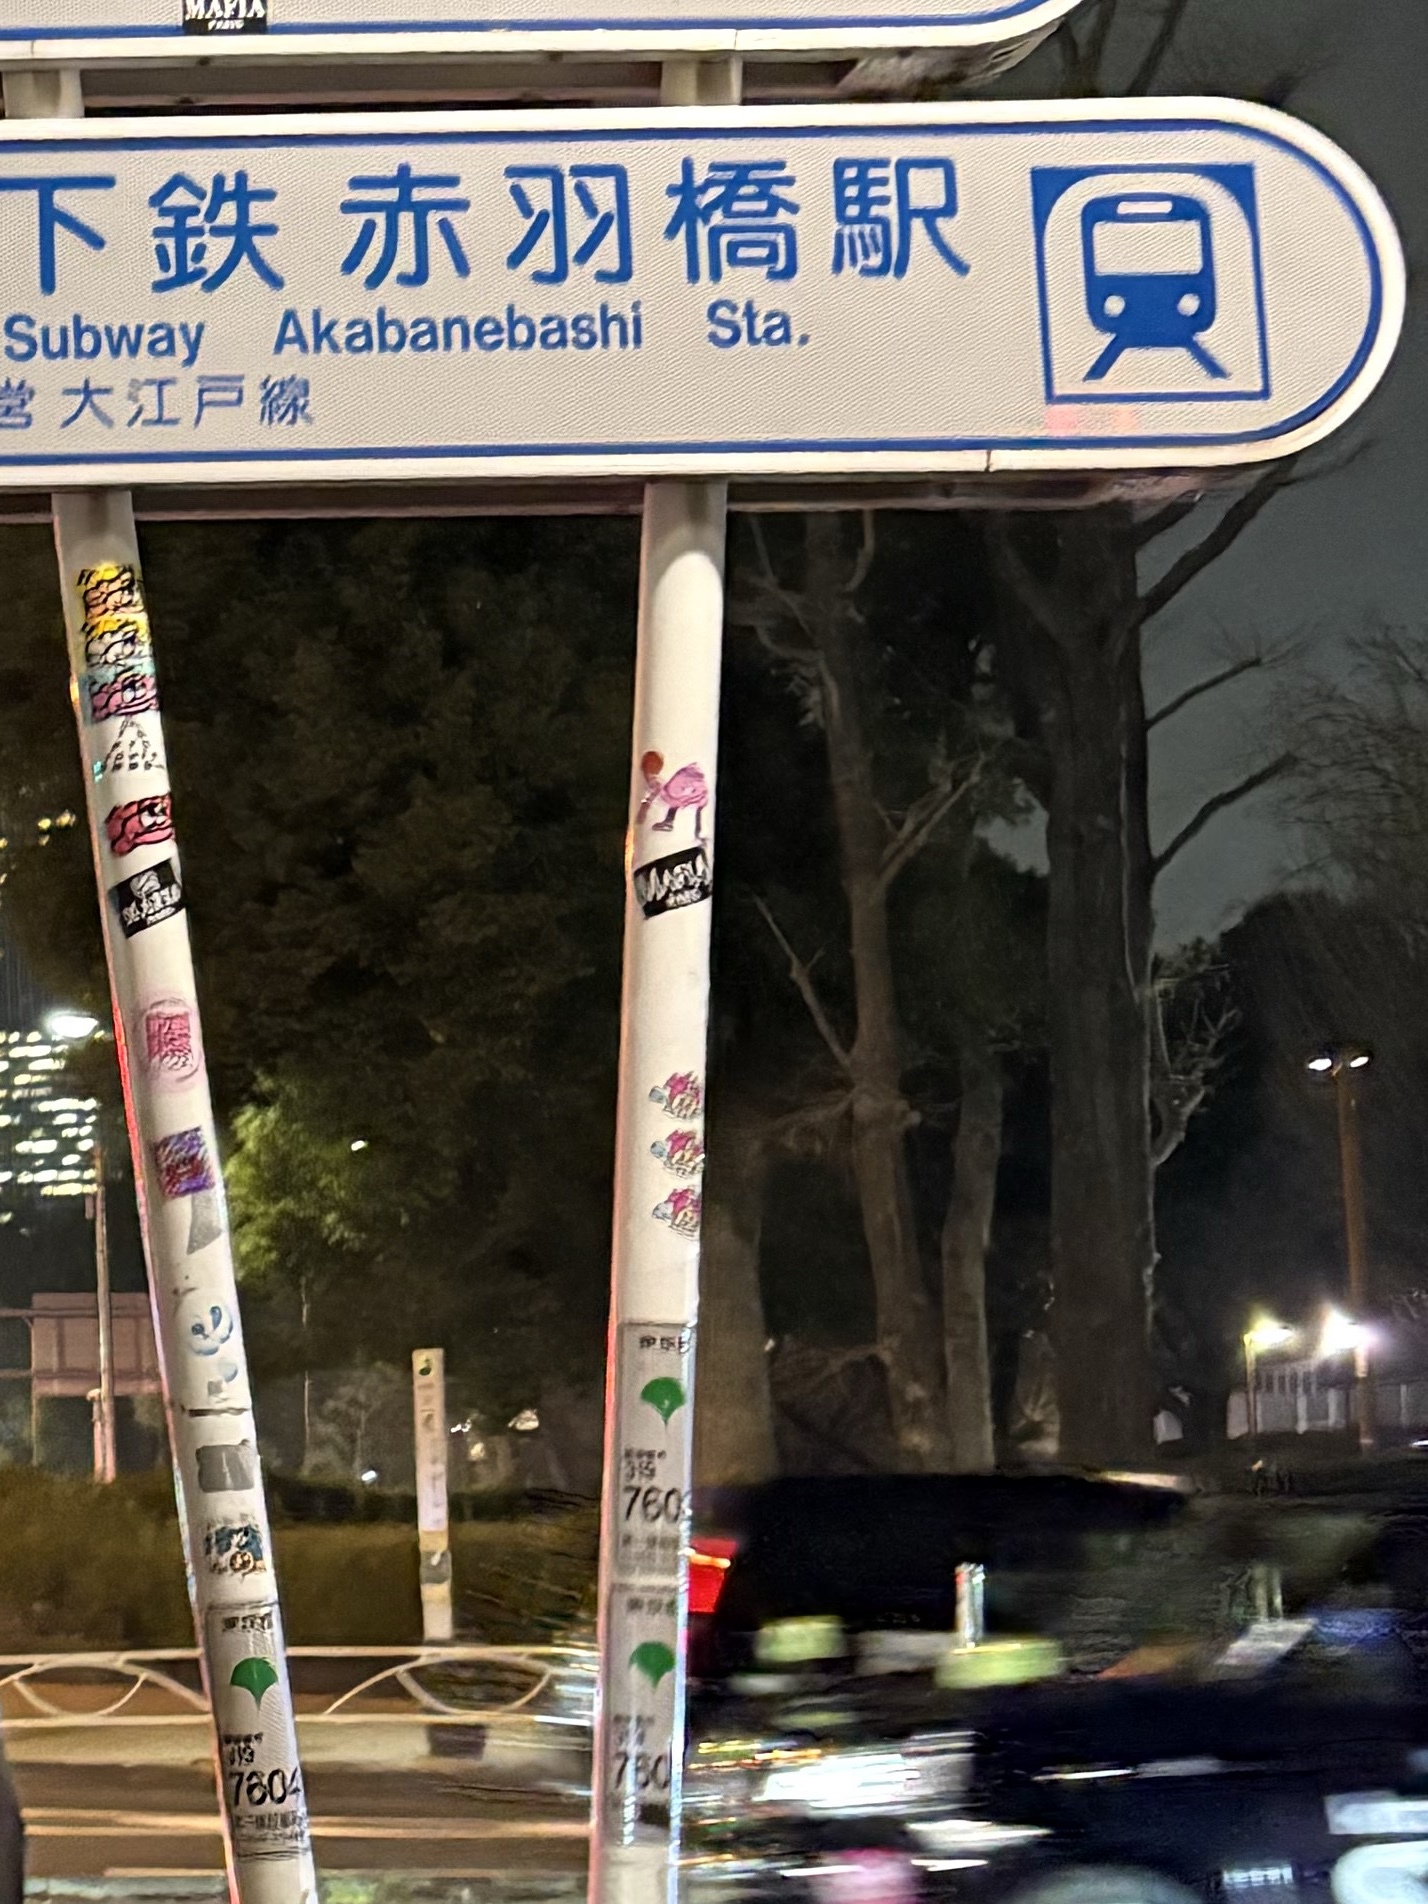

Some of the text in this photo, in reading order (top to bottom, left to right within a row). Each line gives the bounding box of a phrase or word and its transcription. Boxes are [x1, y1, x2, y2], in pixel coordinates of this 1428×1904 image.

[339, 156, 971, 291] 赤羽橋駅
[4, 299, 808, 368] Subway Akabanebashi Sta.
[60, 373, 313, 430] 大江戸線
